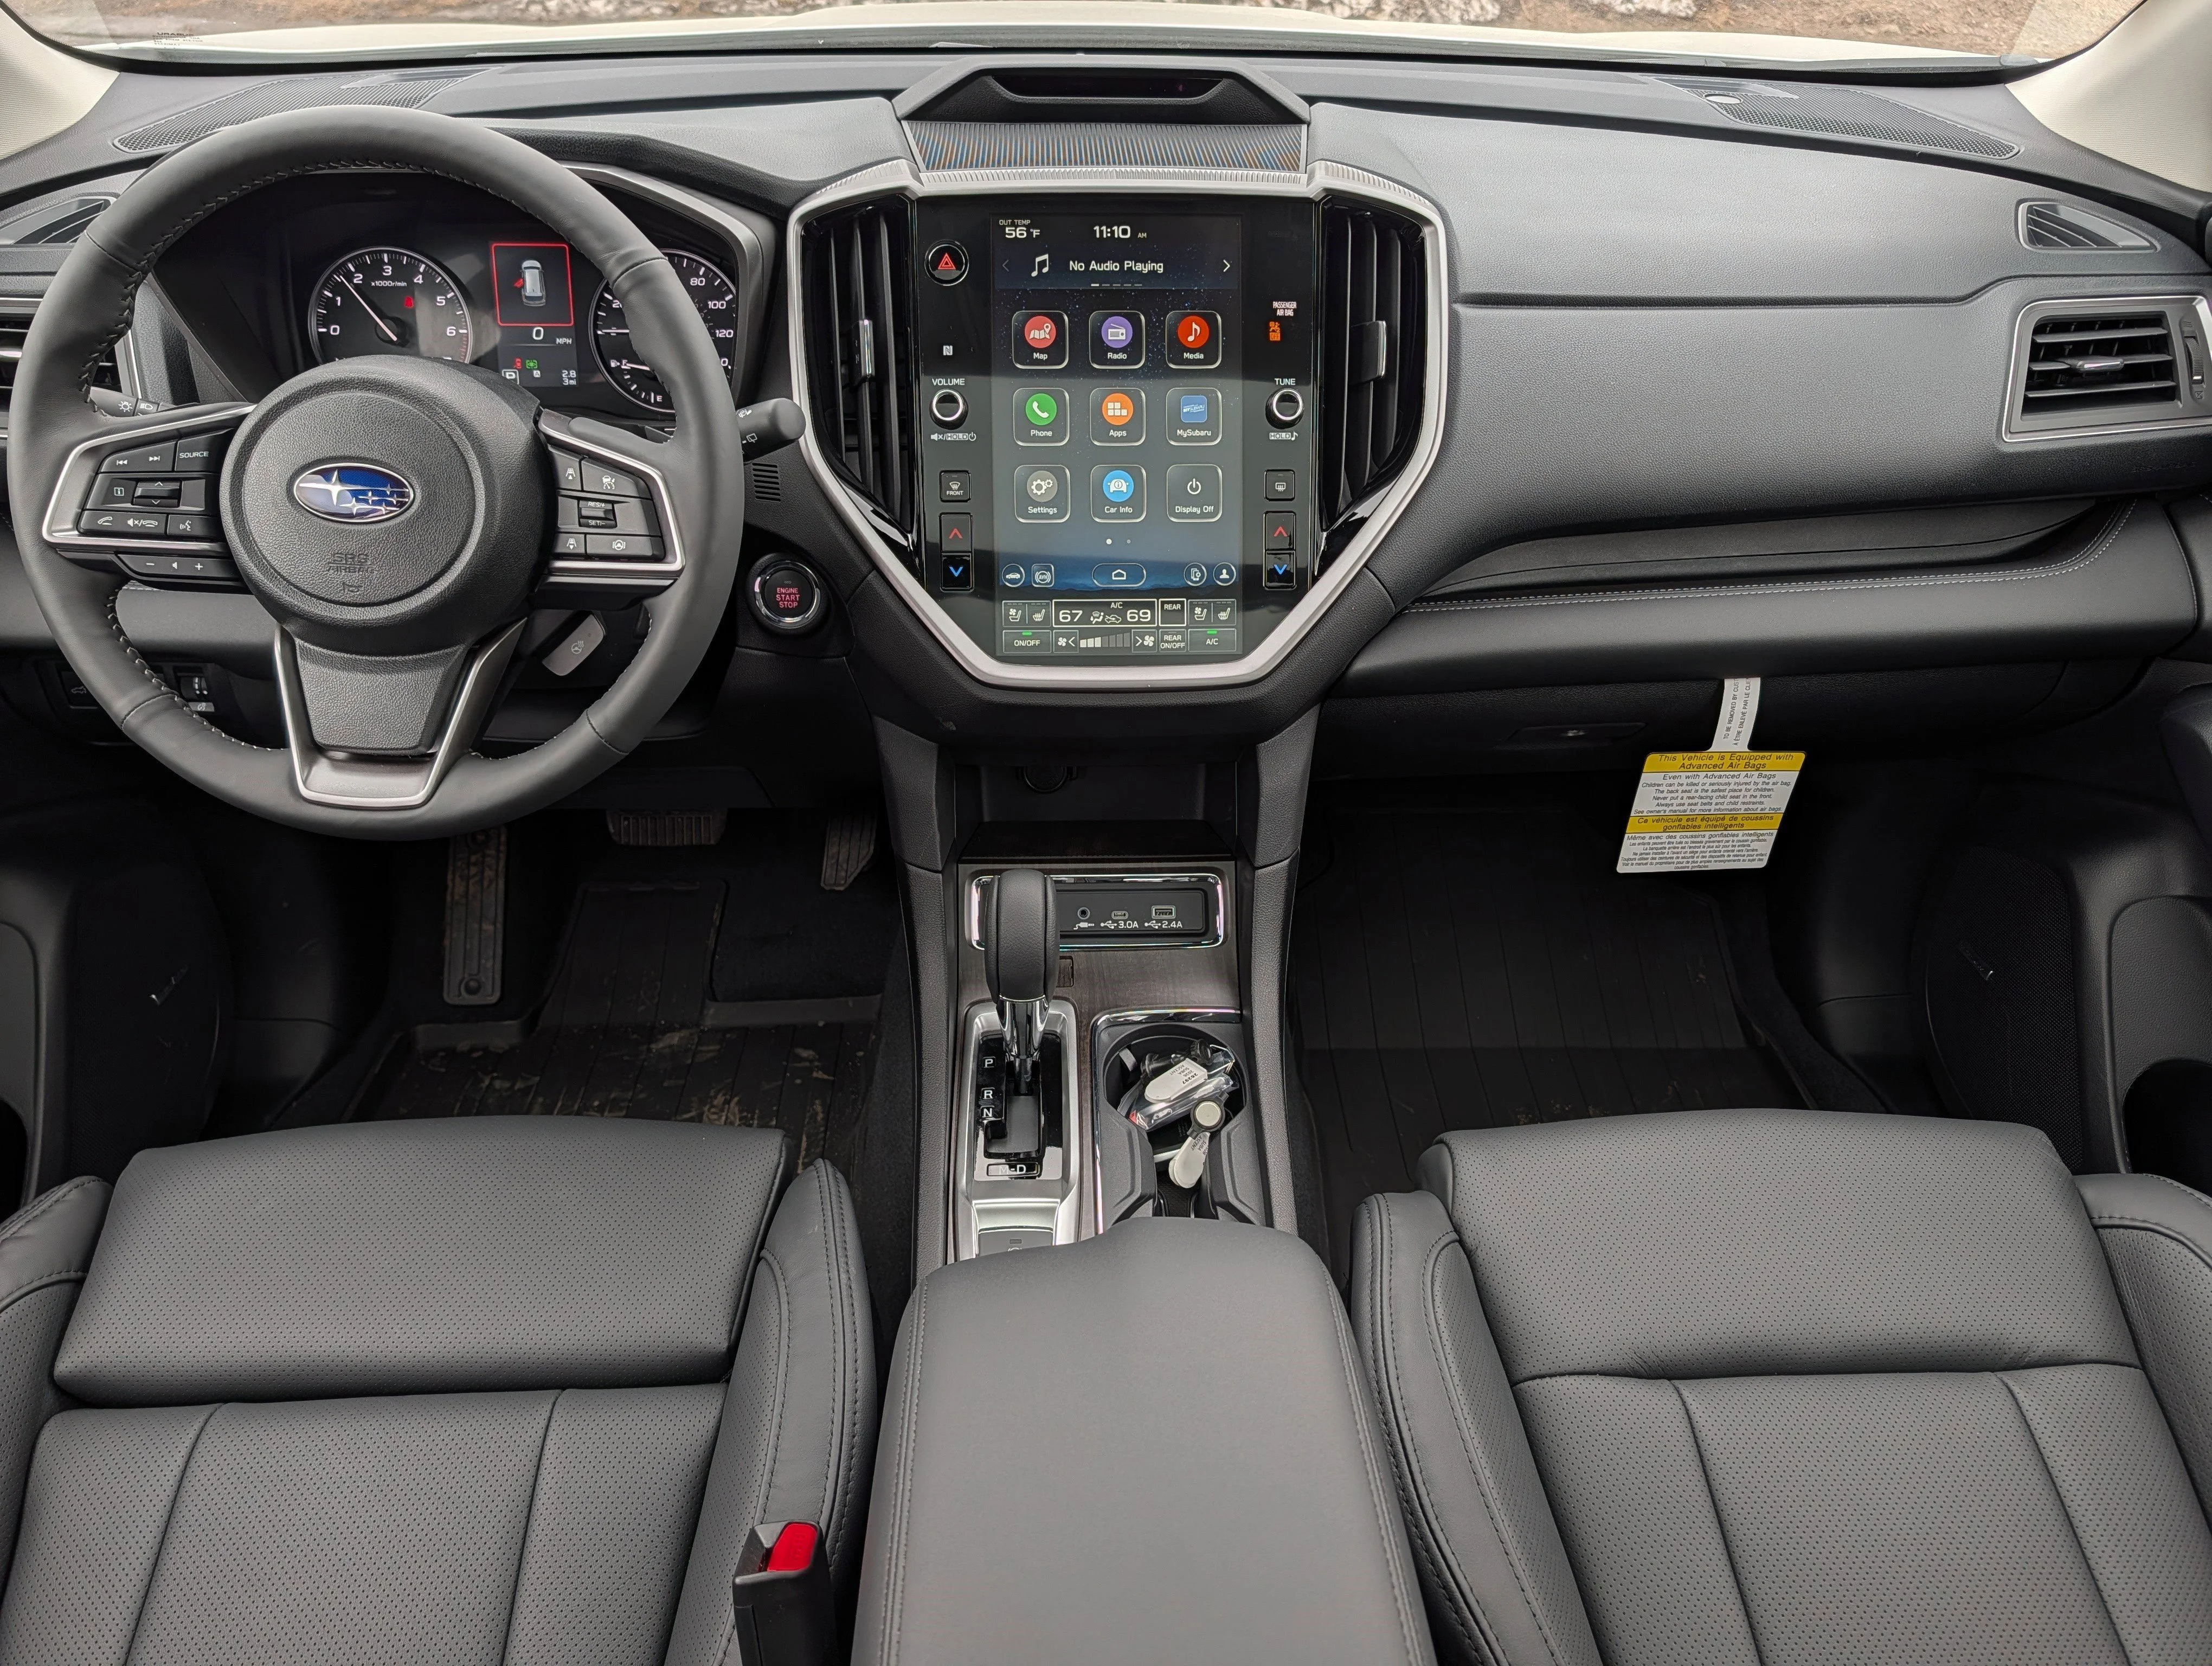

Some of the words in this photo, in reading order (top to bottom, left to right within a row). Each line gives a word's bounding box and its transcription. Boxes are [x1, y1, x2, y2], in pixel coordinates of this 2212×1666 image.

[1005, 227, 1027, 238] 56
[1093, 226, 1131, 239] 11:10
[383, 266, 392, 275] 3
[1070, 261, 1084, 271] No
[1090, 261, 1119, 271] Audio
[1124, 261, 1163, 273] Playing
[353, 274, 363, 283] 2
[414, 274, 423, 284] 4
[336, 297, 341, 306] 1
[436, 296, 446, 306] 5
[708, 301, 726, 309] 100
[330, 325, 339, 335] 0
[446, 326, 456, 336] 6
[532, 327, 544, 340] 0
[333, 554, 370, 563] SRS
[1059, 611, 1083, 622] 67
[1127, 610, 1150, 621] 69
[1727, 702, 1736, 725] REMOVED
[1729, 753, 1772, 762] Equipped
[1744, 762, 1766, 770] Bags
[985, 1059, 993, 1067] P
[1169, 1065, 1185, 1075] ASCENT
[1182, 1073, 1198, 1084] 26297
[983, 1108, 992, 1117] N
[1191, 1136, 1202, 1151] ASCENT
[1198, 1140, 1206, 1151] SUBA
